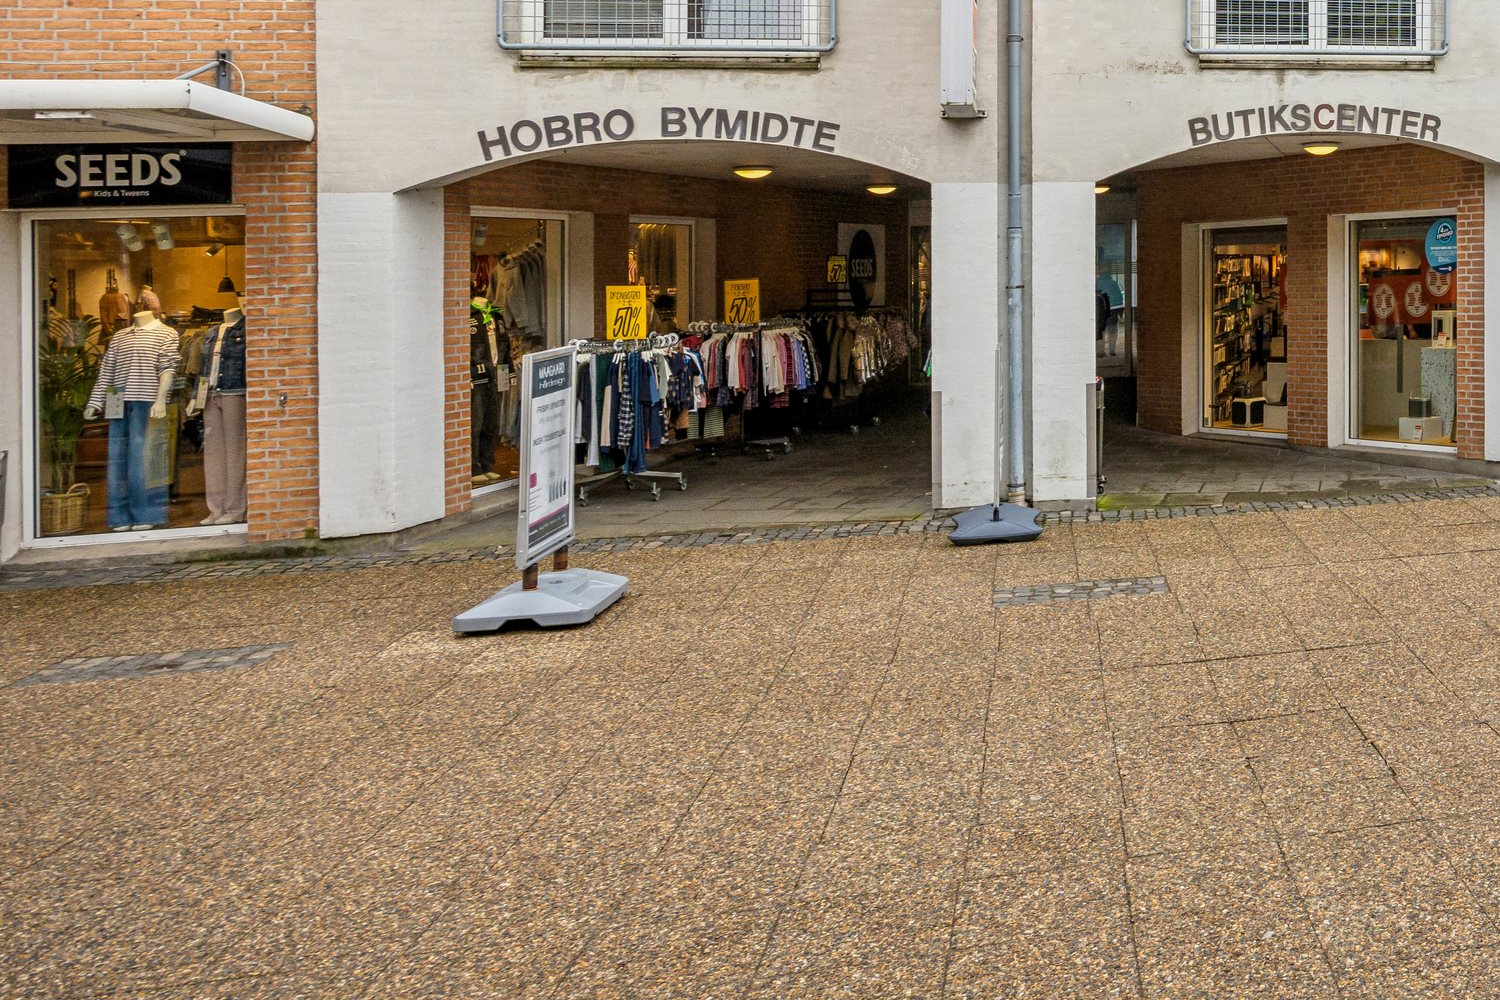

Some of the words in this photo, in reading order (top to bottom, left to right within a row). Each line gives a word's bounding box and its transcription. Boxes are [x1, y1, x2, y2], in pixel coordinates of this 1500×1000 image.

[477, 108, 635, 162] HOBRO
[660, 106, 841, 153] BYMIDTE
[1188, 103, 1442, 147] BUTIKSCENTER
[55, 152, 183, 188] SEEDS
[94, 189, 112, 198] Kids
[121, 189, 150, 198] Tweens
[851, 258, 873, 278] SEEDS
[613, 306, 642, 338] 50%
[729, 296, 758, 324] 50%
